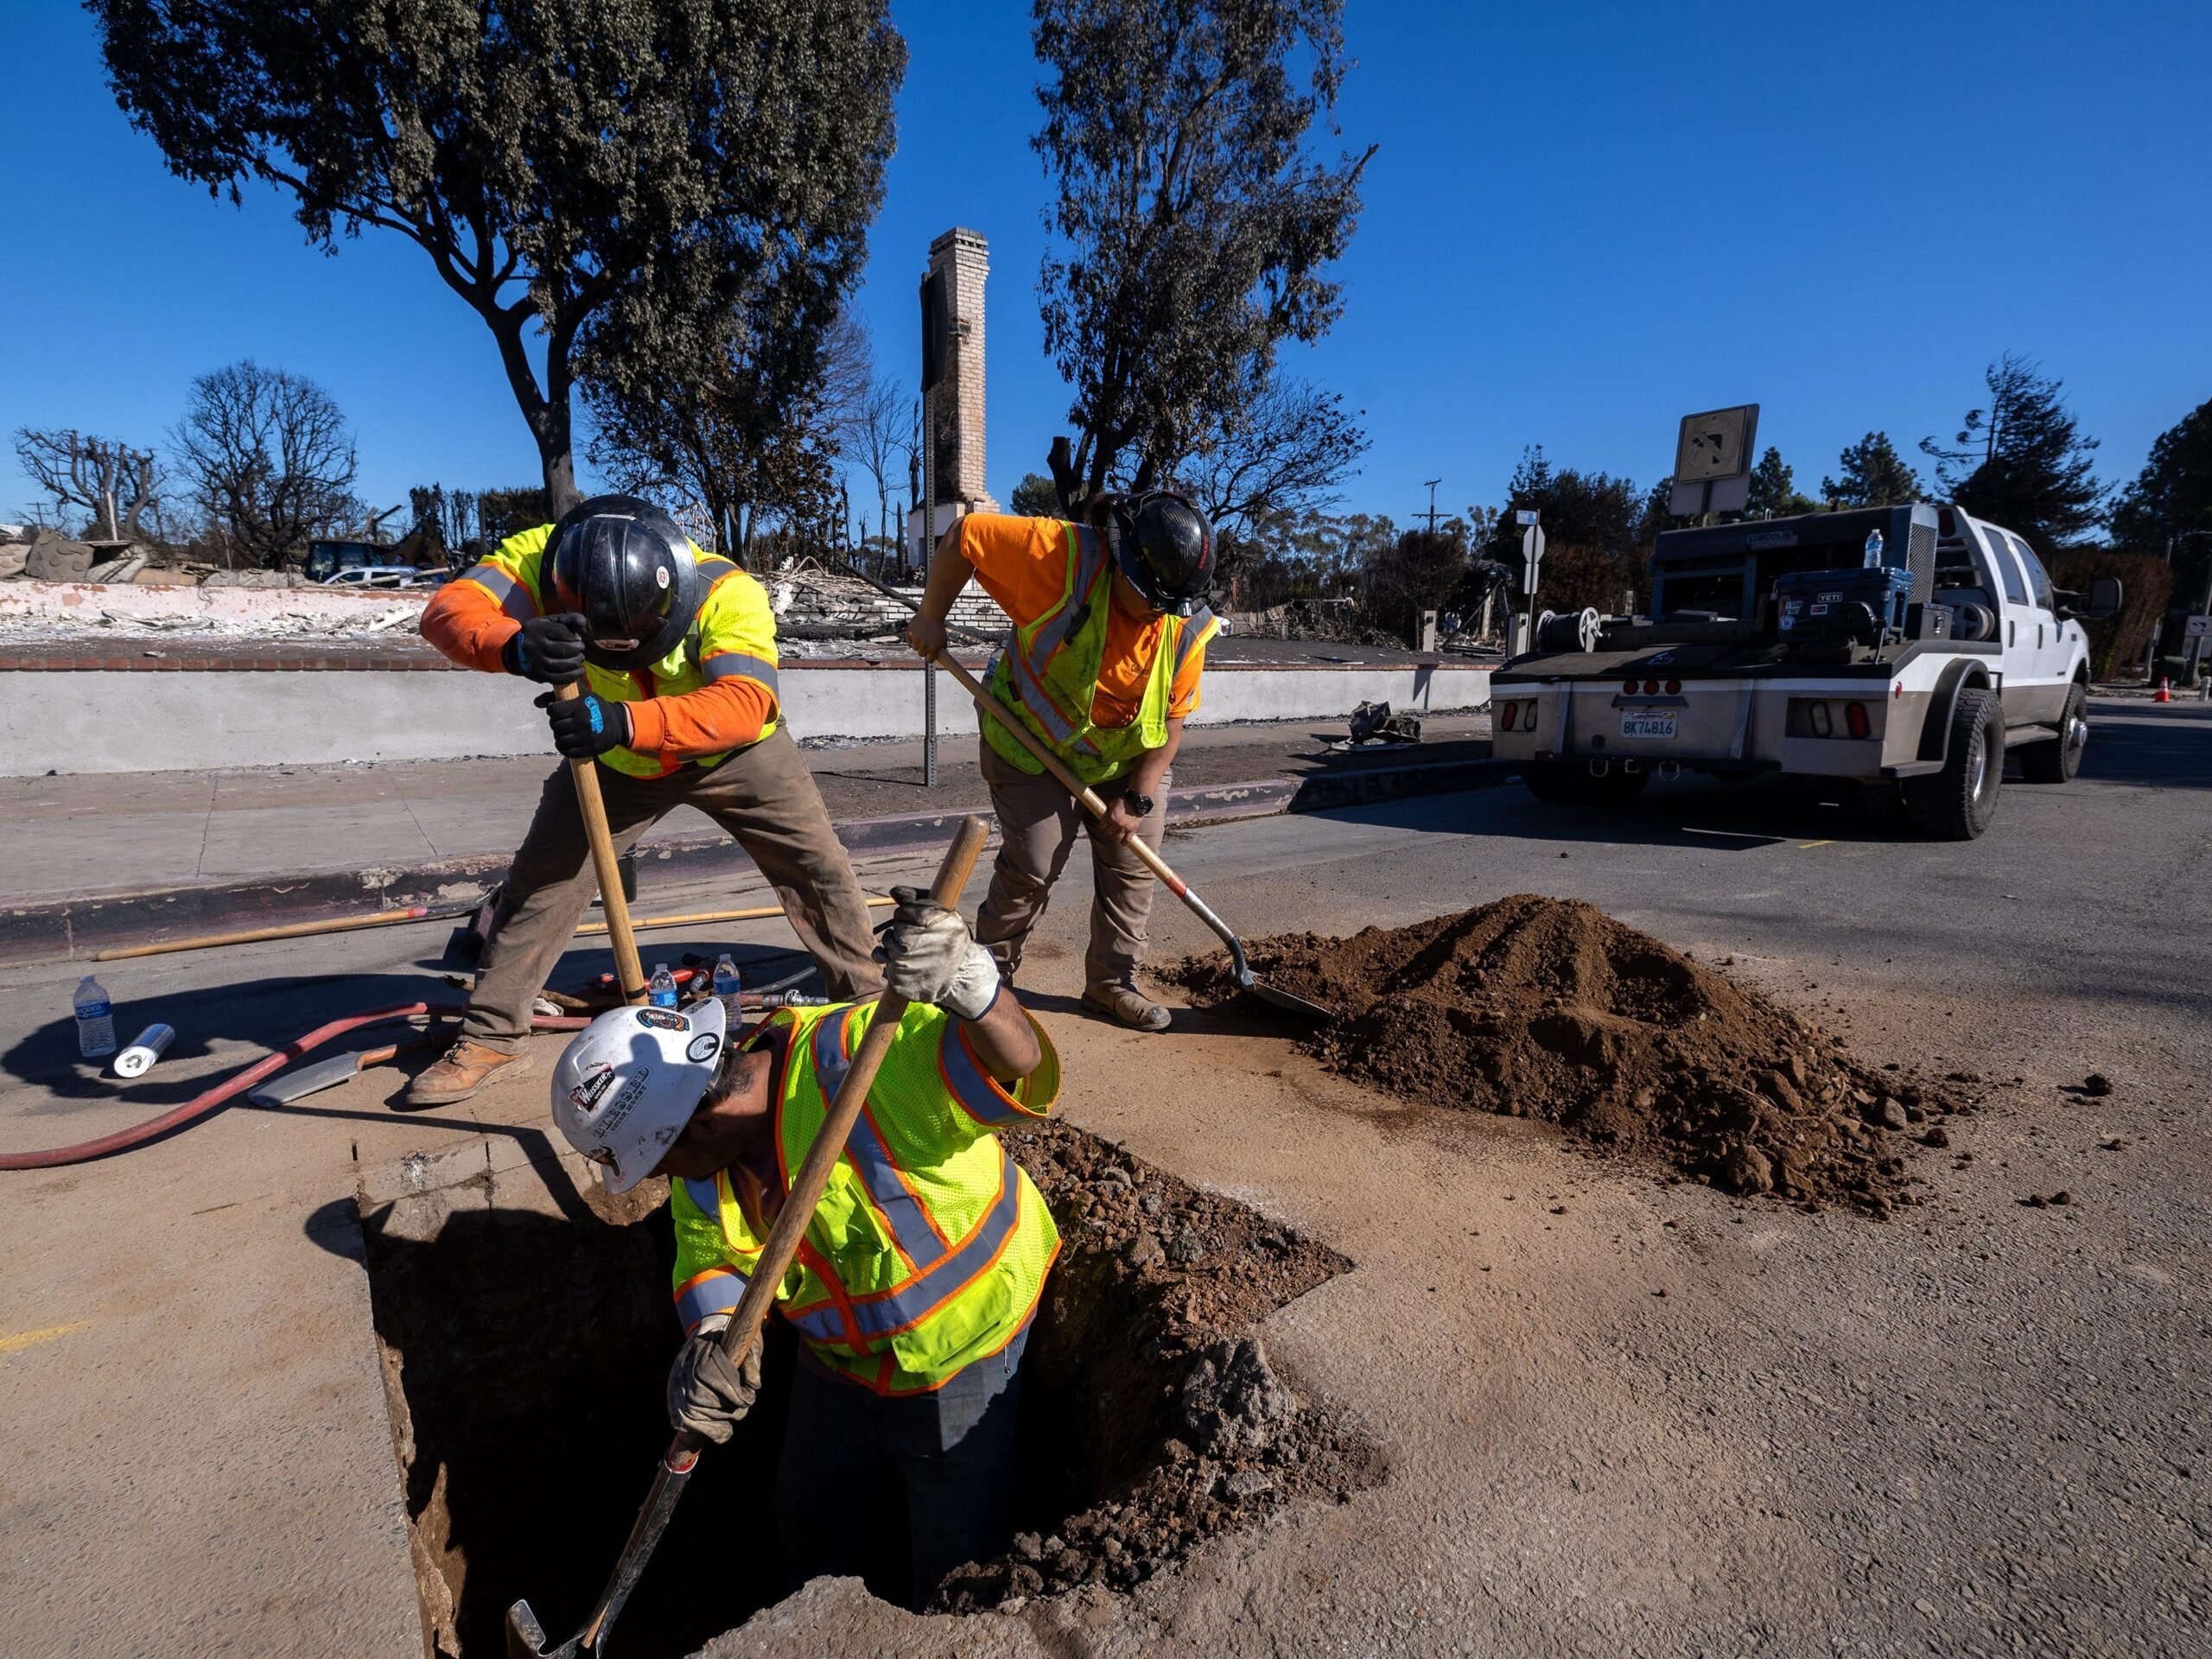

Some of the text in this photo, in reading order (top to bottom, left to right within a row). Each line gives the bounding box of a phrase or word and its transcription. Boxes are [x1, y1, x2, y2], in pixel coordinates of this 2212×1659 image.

[1624, 721, 1673, 734] 8K74816
[578, 1072, 609, 1104] WEISSKER
[591, 1067, 650, 1139] BLESSED
[626, 1084, 647, 1112] MONEY
